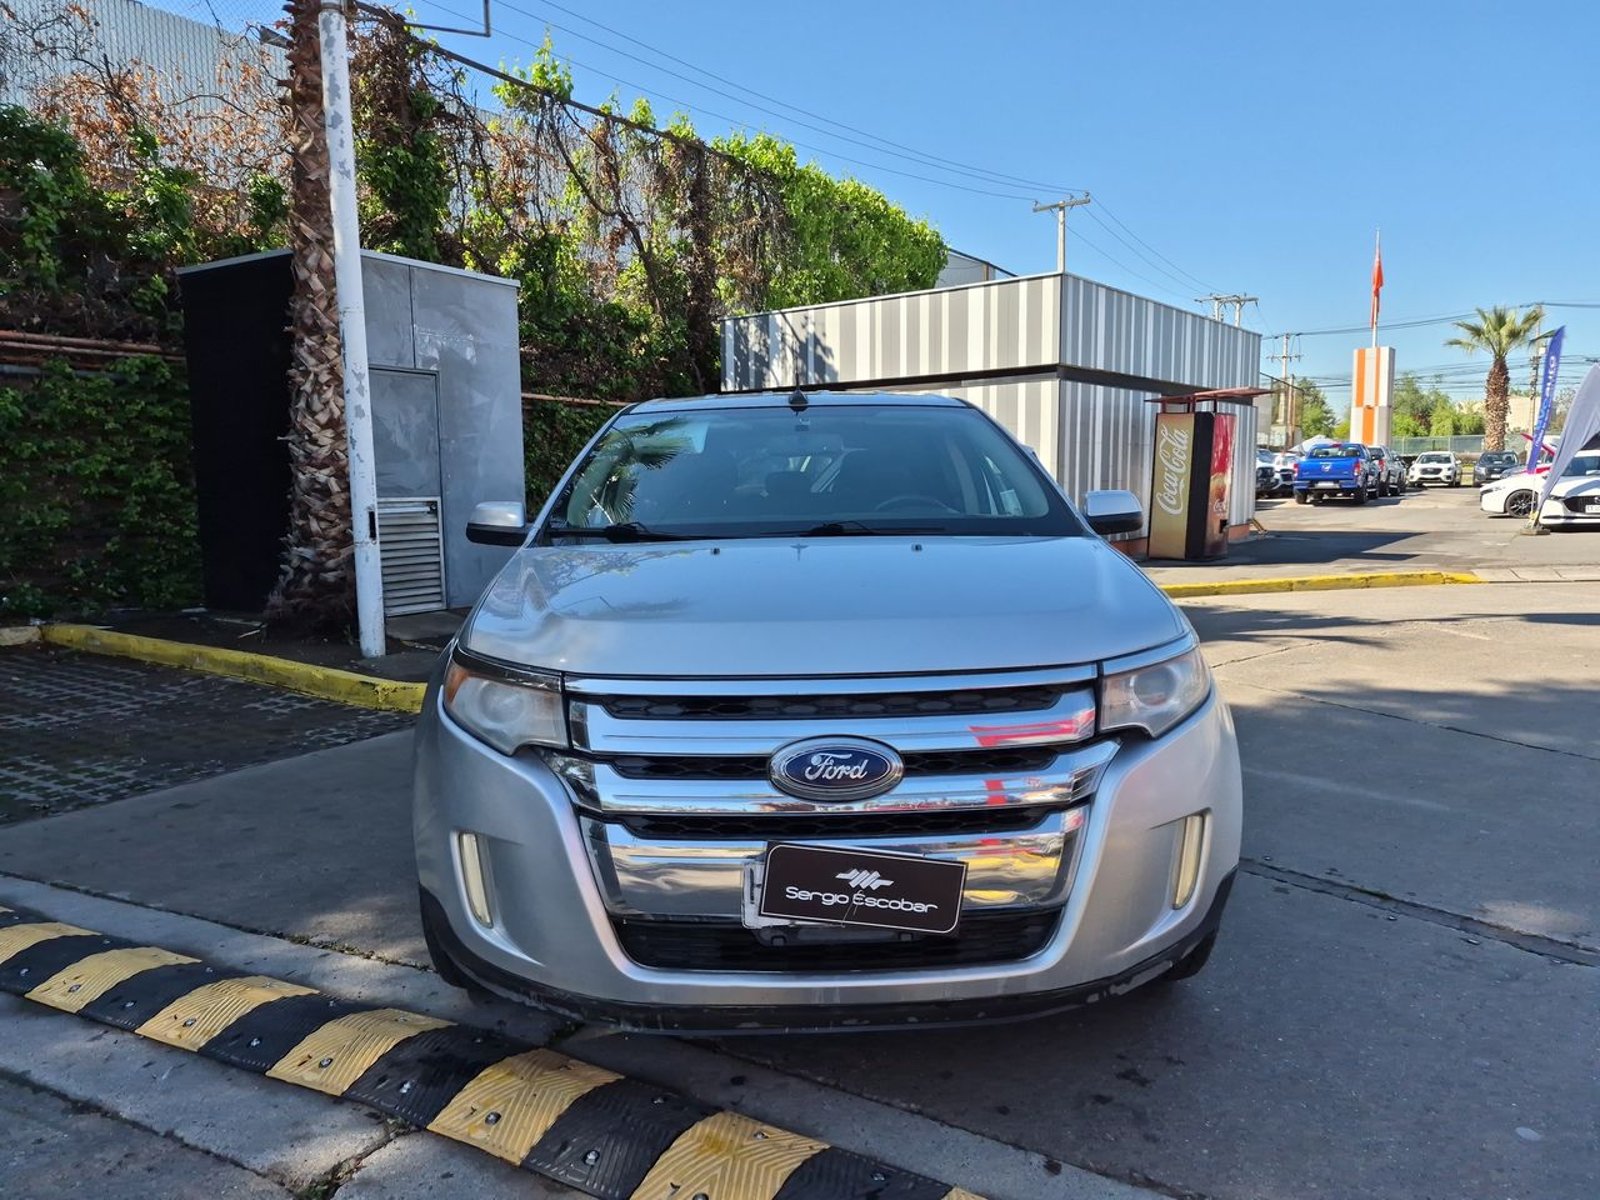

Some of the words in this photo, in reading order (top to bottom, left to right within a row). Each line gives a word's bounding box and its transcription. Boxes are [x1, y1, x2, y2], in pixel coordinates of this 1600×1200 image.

[804, 753, 869, 780] Ford
[785, 886, 849, 905] Sergio
[852, 893, 938, 913] Escobar
